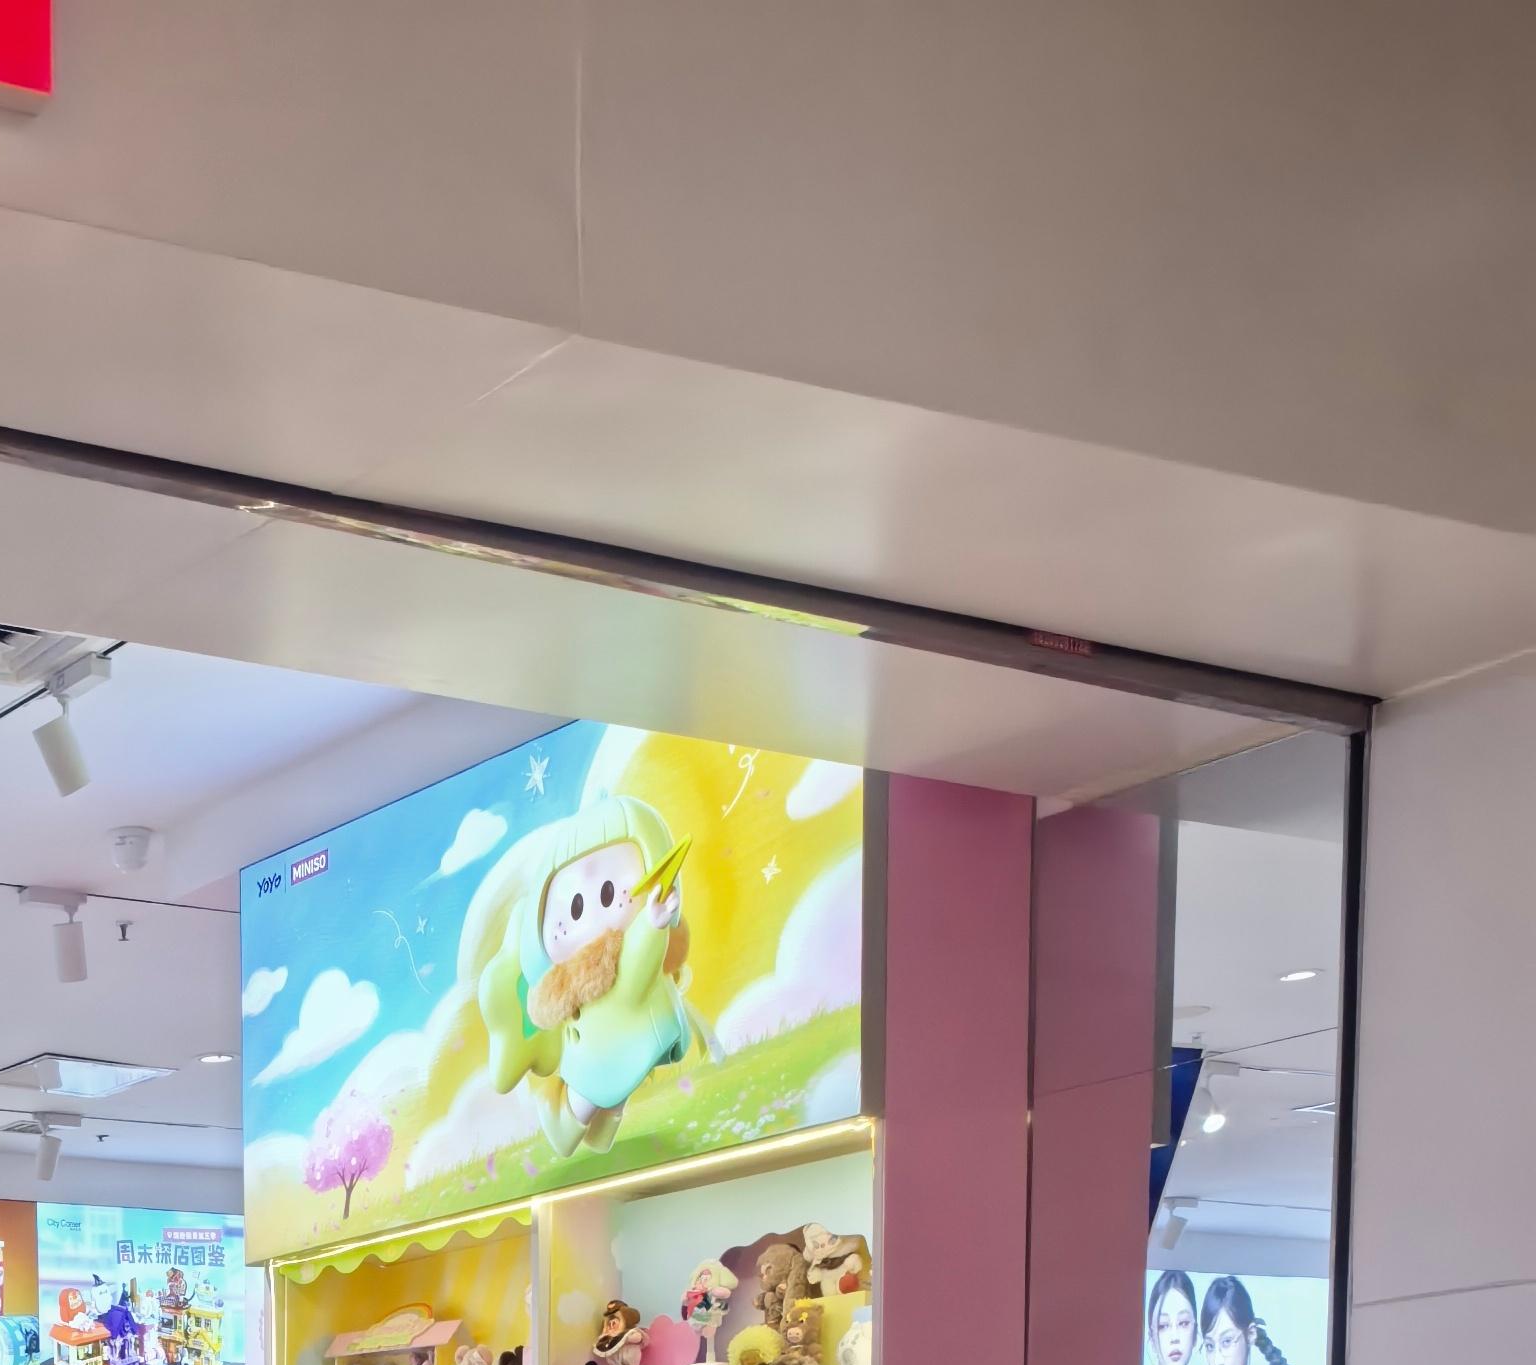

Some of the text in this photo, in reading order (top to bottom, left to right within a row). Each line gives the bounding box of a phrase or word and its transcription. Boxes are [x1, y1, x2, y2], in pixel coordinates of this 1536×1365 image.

[257, 854, 326, 898] YOYO MINISO
[116, 1240, 225, 1267] 周末探店图鉴
